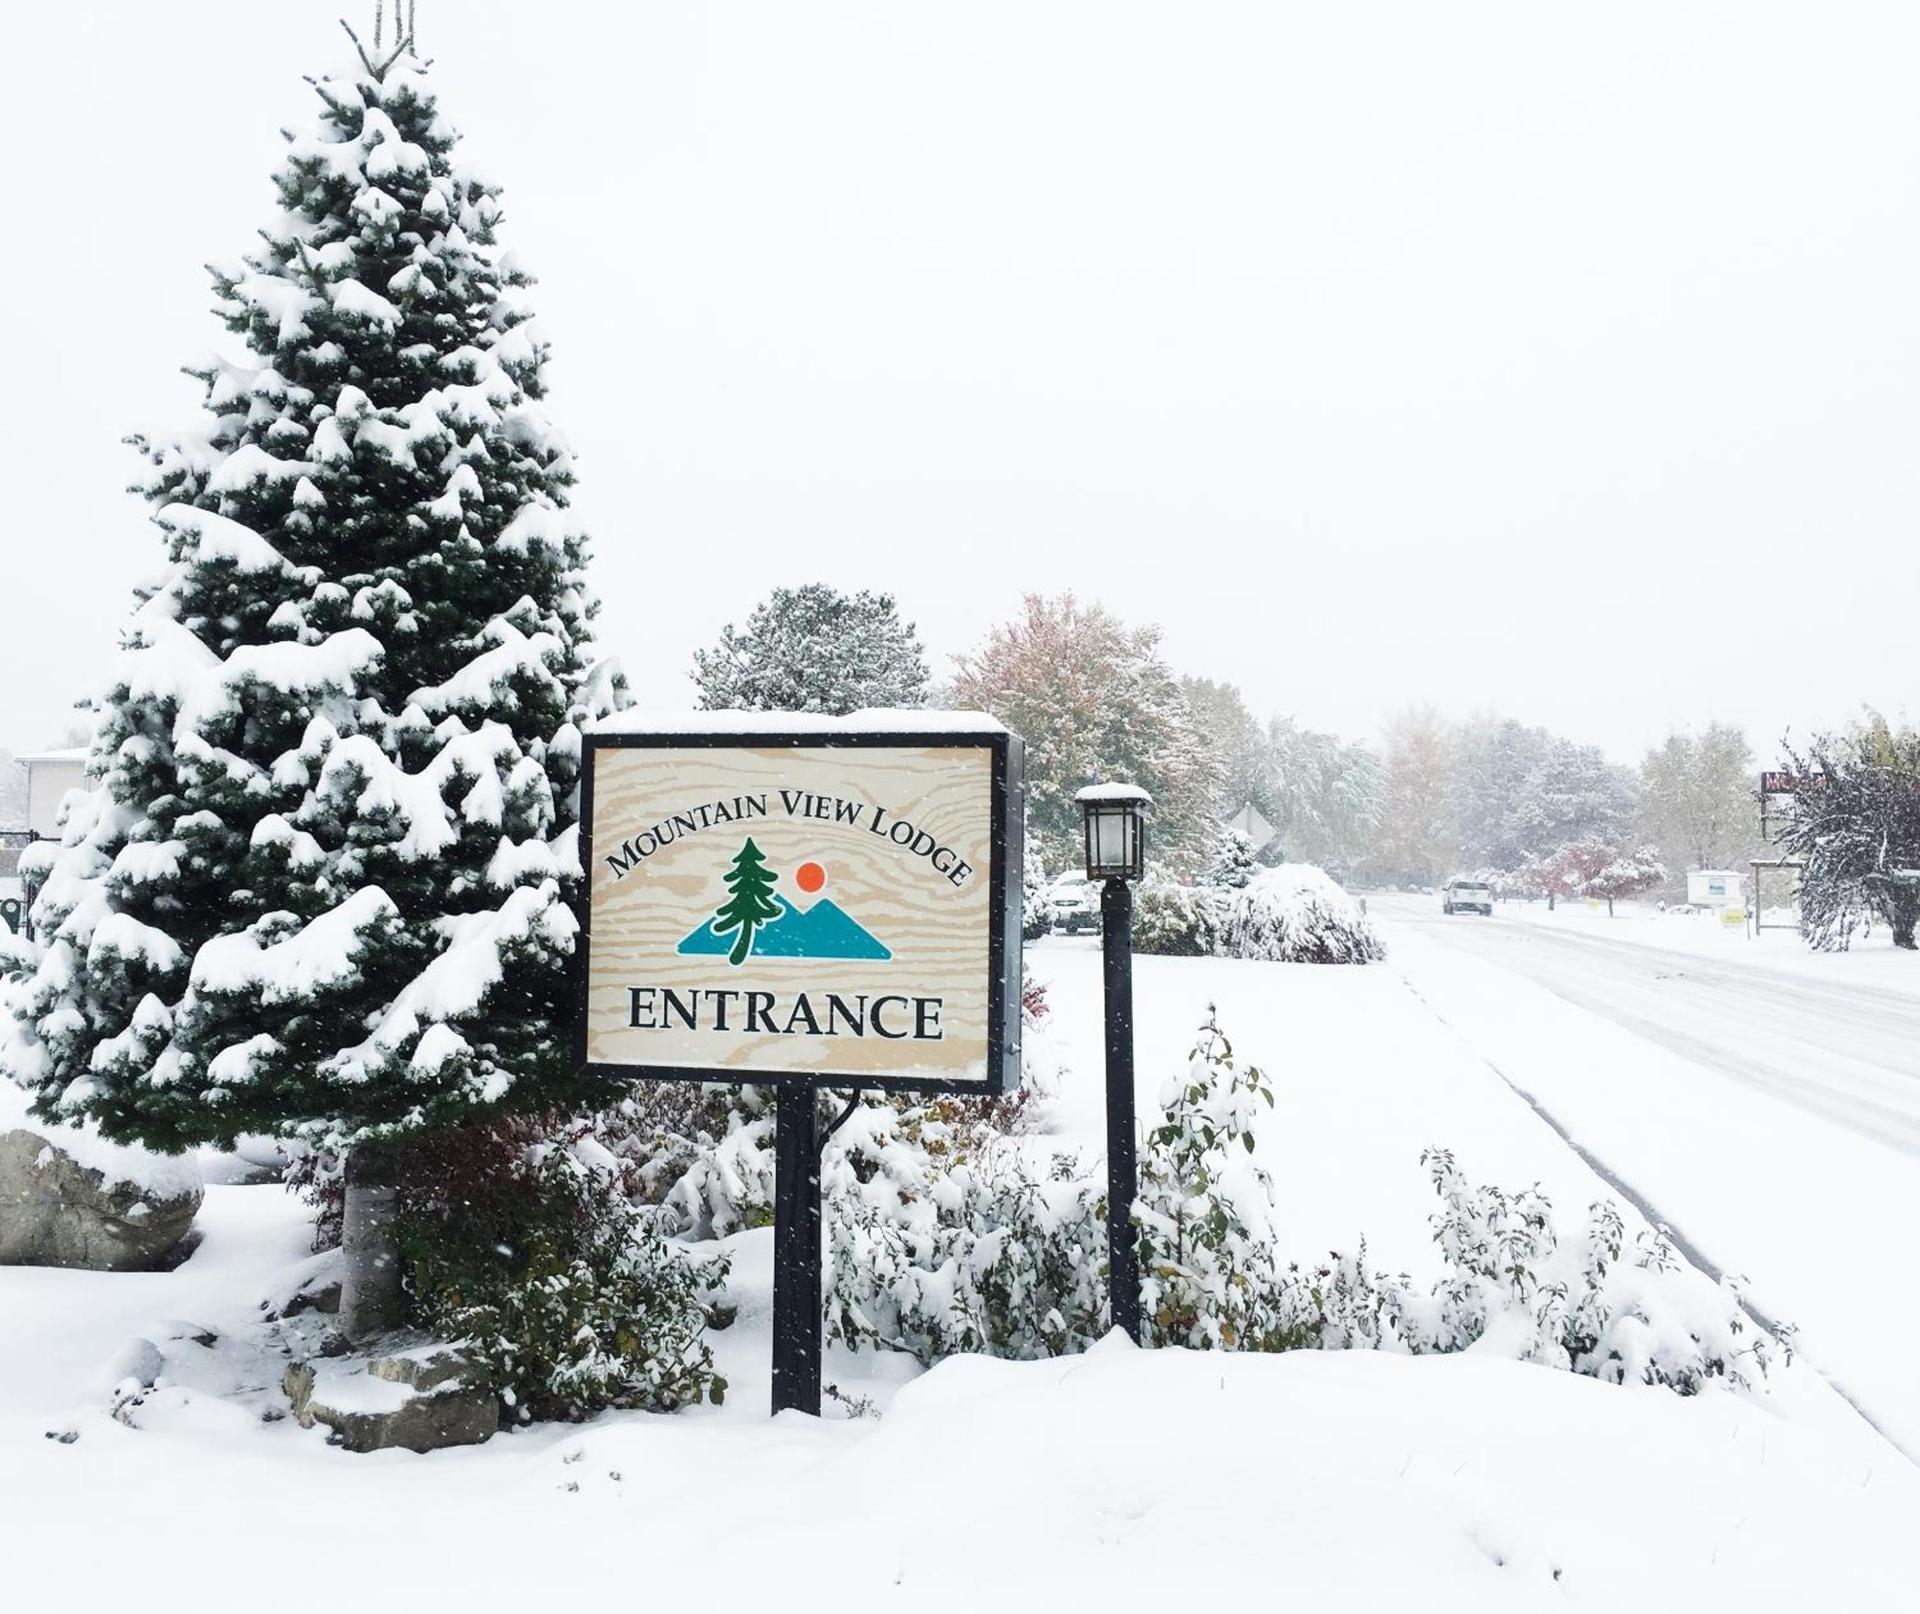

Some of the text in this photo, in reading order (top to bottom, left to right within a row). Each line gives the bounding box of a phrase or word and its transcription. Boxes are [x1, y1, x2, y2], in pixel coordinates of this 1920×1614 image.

[605, 790, 973, 887] MOUNTAIN VIEW LODGE
[628, 987, 943, 1040] ENTRANCE
